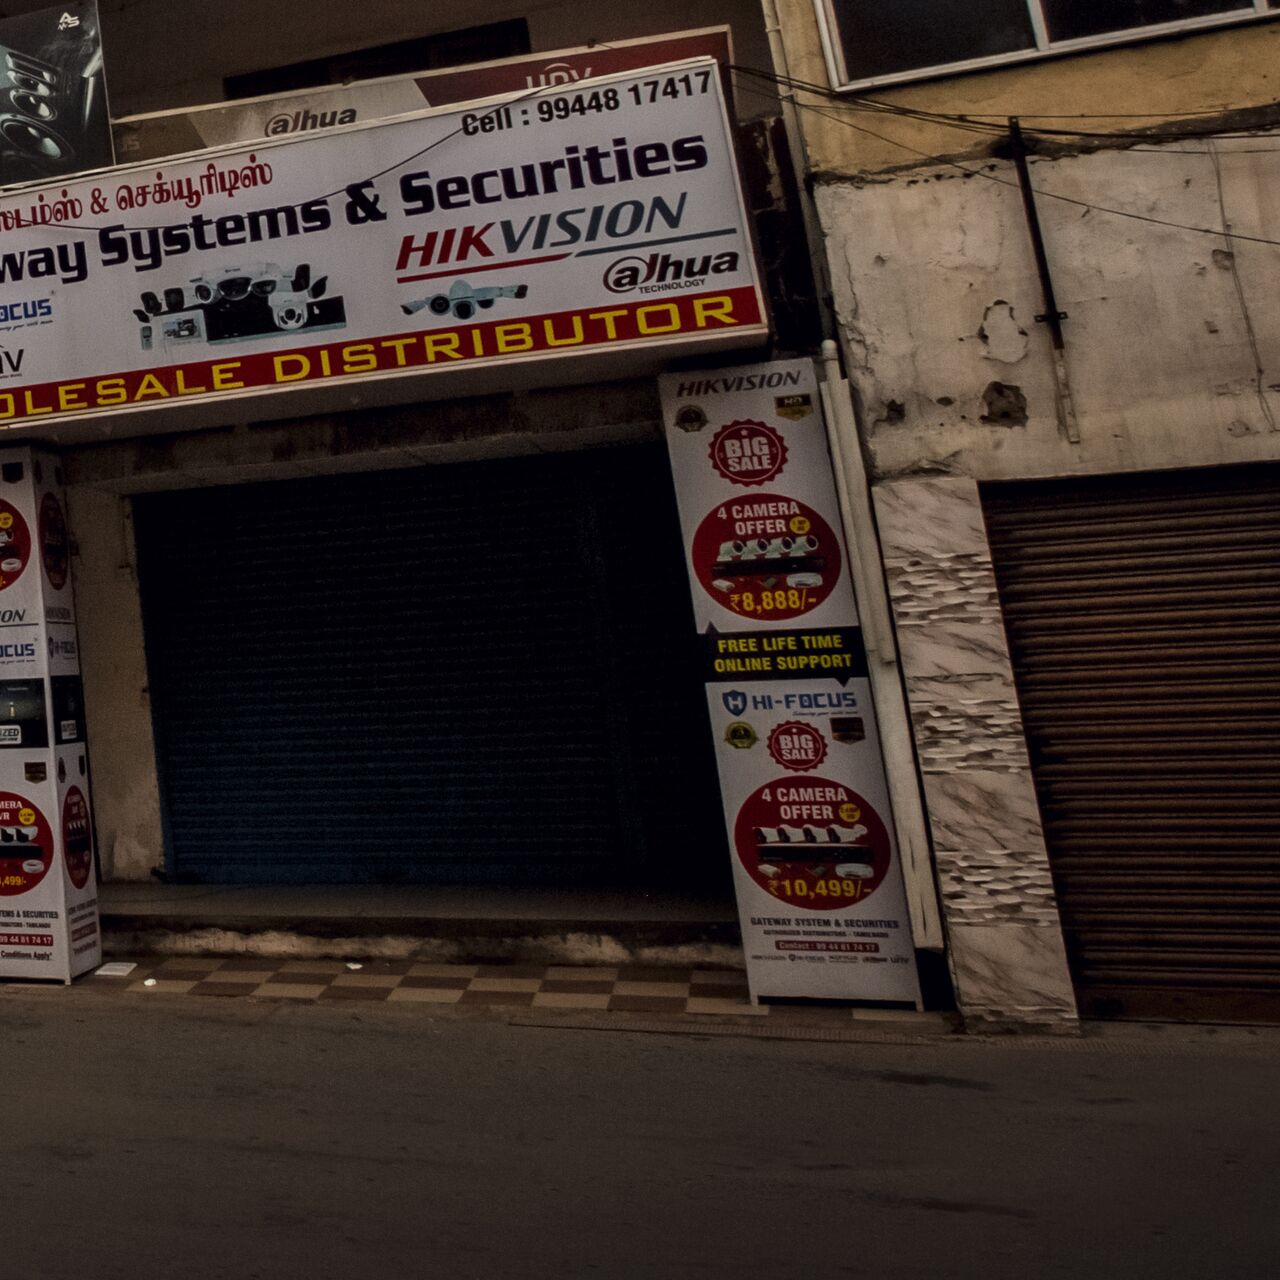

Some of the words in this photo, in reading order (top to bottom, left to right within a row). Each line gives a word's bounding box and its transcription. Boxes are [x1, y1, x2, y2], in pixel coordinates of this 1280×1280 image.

[462, 106, 514, 136] Cell
[538, 87, 620, 123] 99448
[627, 70, 712, 108] 17417
[90, 188, 109, 214] &
[99, 198, 332, 272] Systems
[345, 179, 386, 224] &
[400, 134, 708, 216] Securities
[396, 192, 688, 271] HIKVISION
[639, 278, 706, 294] TECHNOLOGY
[274, 295, 739, 384] DISTRIBUTOR
[676, 371, 801, 398] HIKVISION
[728, 454, 772, 472] SALE
[717, 508, 727, 520] 4
[732, 501, 800, 519] CAMERA
[736, 519, 787, 535] OFFER
[718, 638, 758, 653] FREE
[763, 636, 797, 651] LIFE
[801, 634, 842, 650] TIME
[714, 656, 772, 673] ONLINE
[776, 654, 852, 670] SUPPORT
[752, 692, 856, 710] HI-FOCUS
[782, 748, 816, 760] SALE
[762, 788, 772, 802] 4
[776, 786, 848, 802] CAMERA
[780, 805, 834, 820] OFFER
